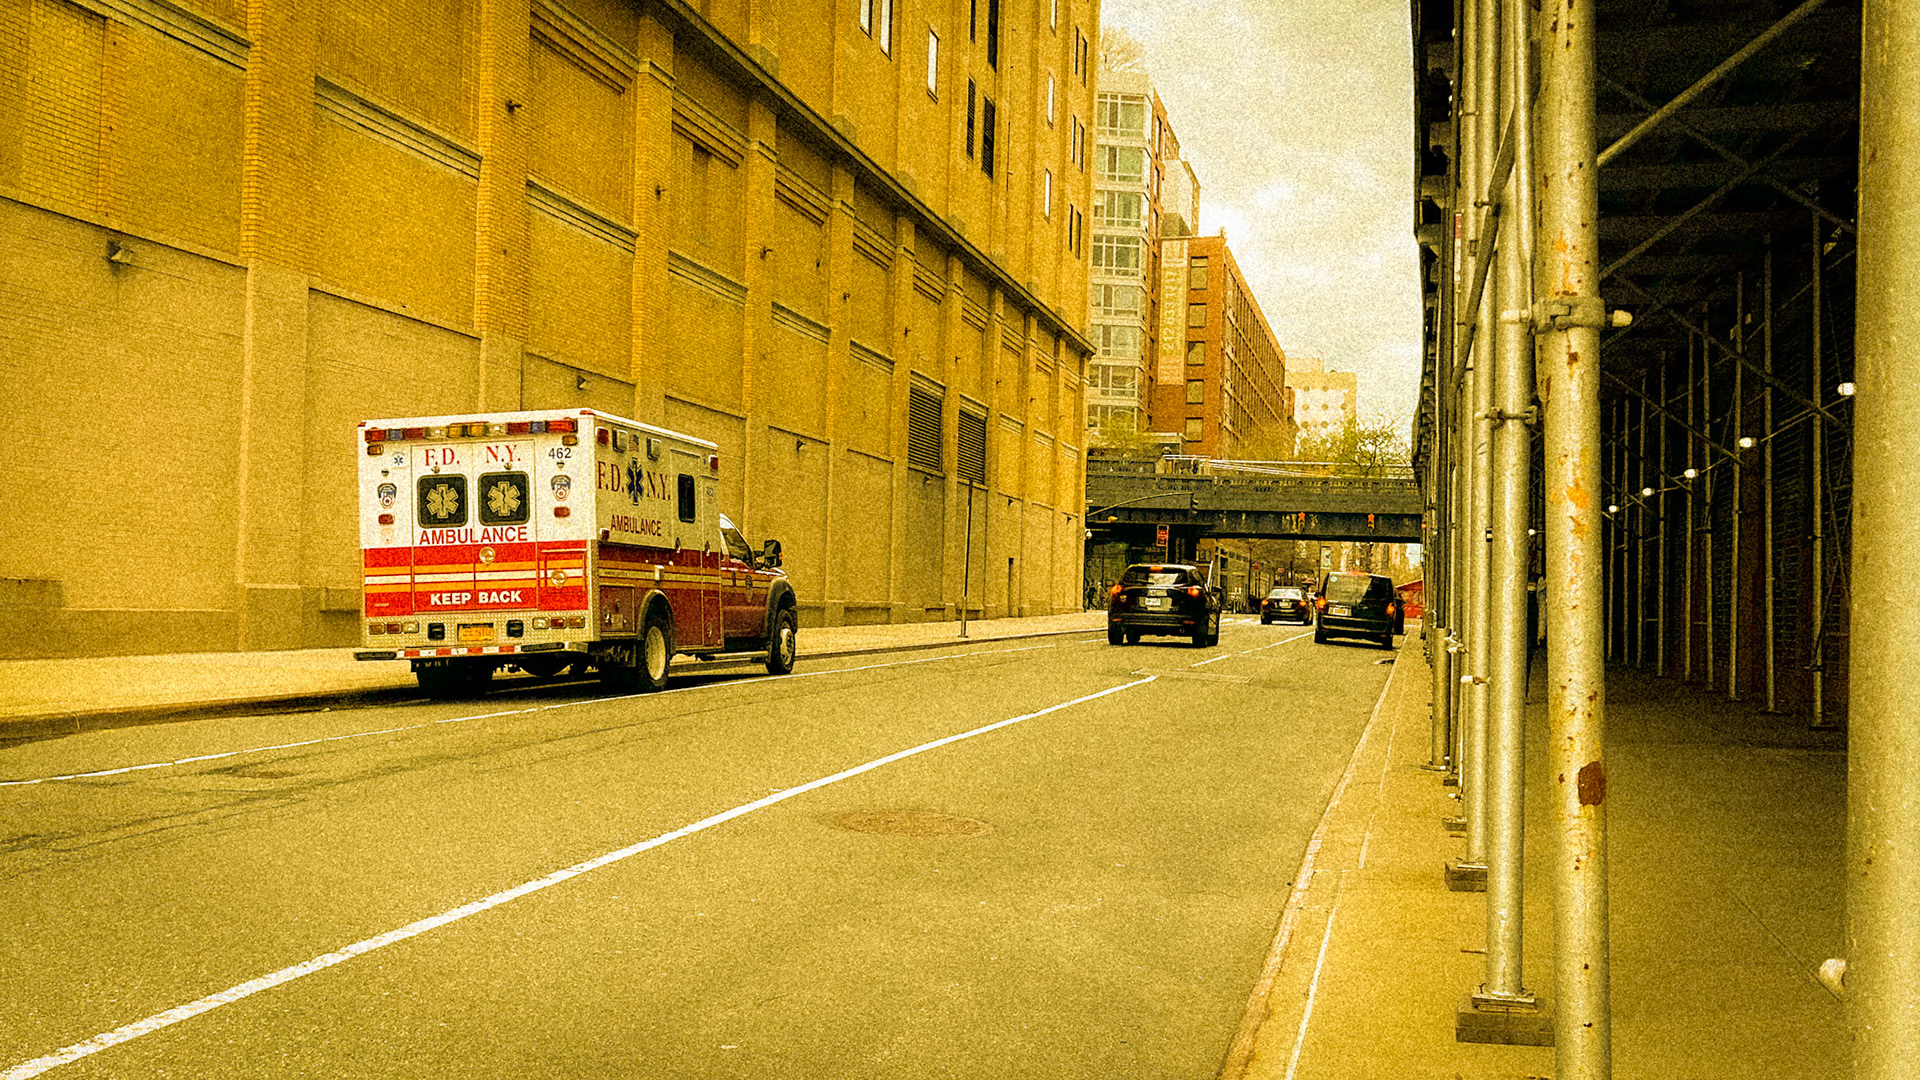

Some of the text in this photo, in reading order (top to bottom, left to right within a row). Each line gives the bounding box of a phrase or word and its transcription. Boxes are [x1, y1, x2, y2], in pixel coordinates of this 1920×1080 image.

[1163, 327, 1175, 351] 212
[548, 447, 572, 459] 462
[610, 514, 662, 537] AMBULANCE
[419, 526, 528, 545] AMBULANCE
[430, 590, 522, 605] KEEP BACK
